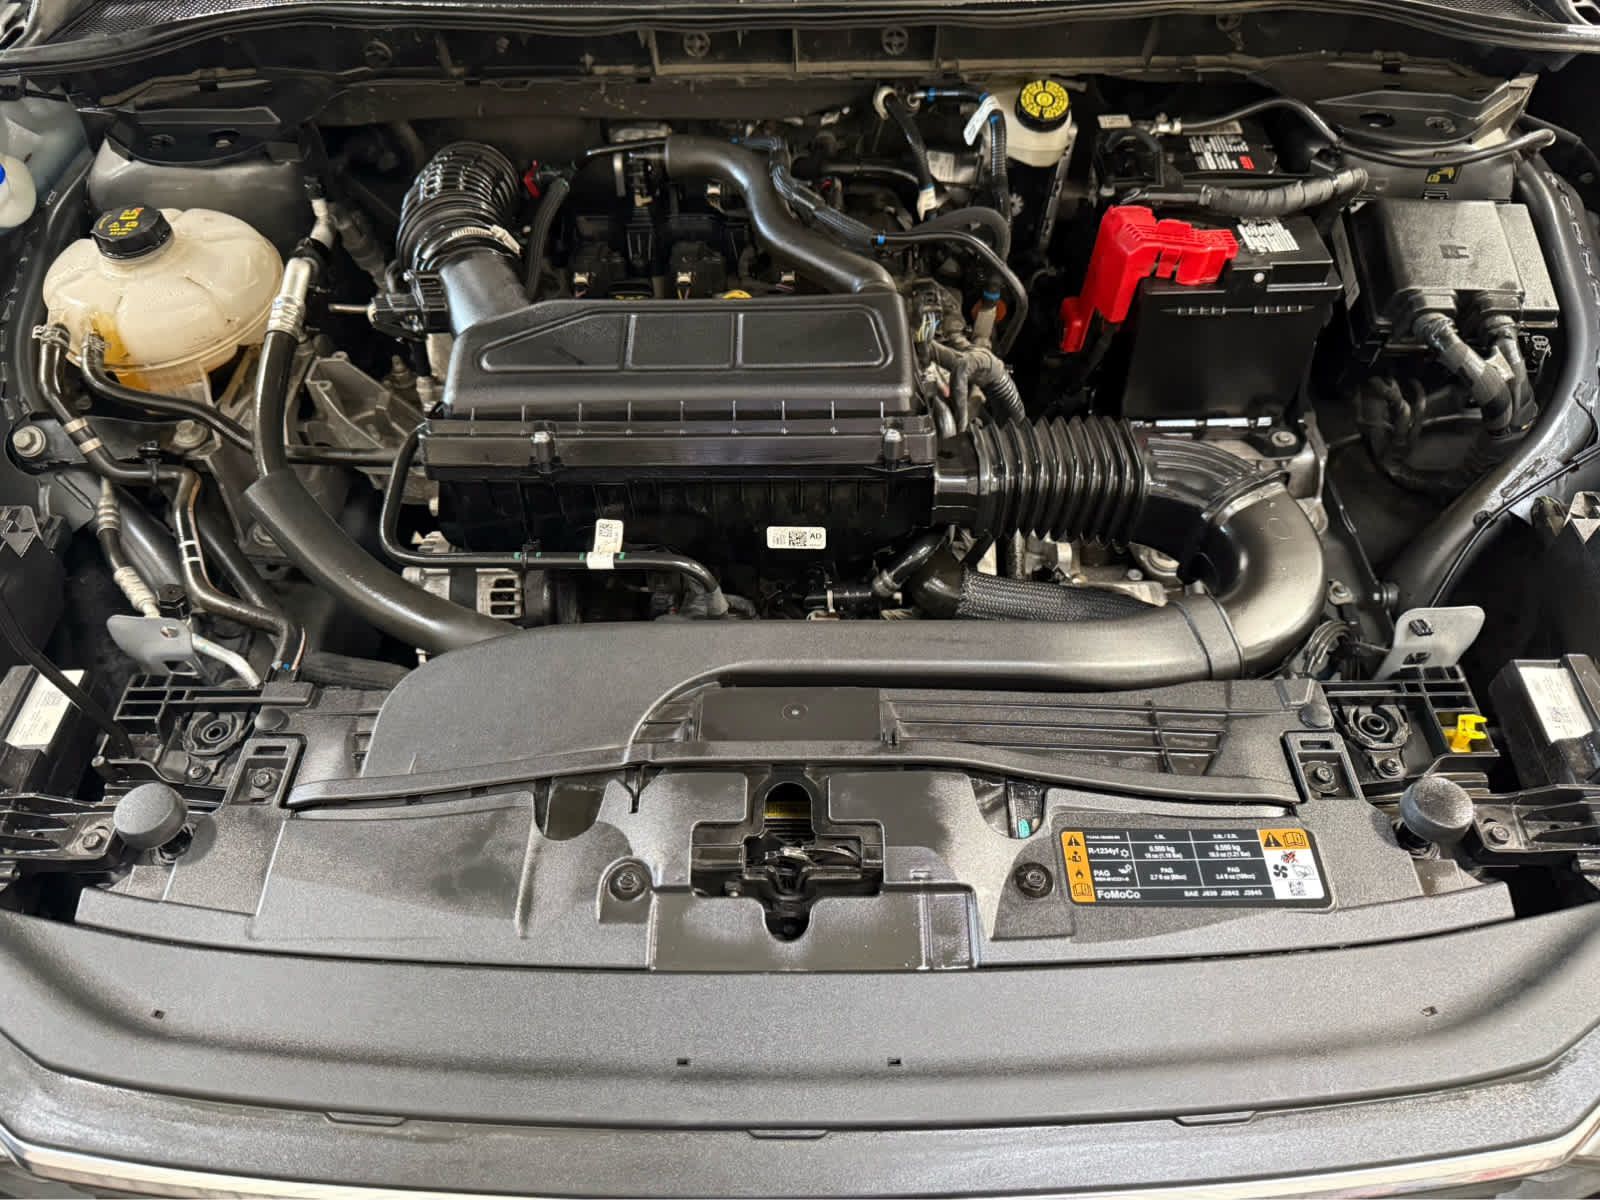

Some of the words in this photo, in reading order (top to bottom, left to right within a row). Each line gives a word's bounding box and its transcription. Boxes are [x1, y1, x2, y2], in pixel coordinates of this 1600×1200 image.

[1087, 847, 1119, 856] R-1234yf
[1093, 869, 1111, 877] PAG
[1097, 890, 1141, 900] FoMoCo
